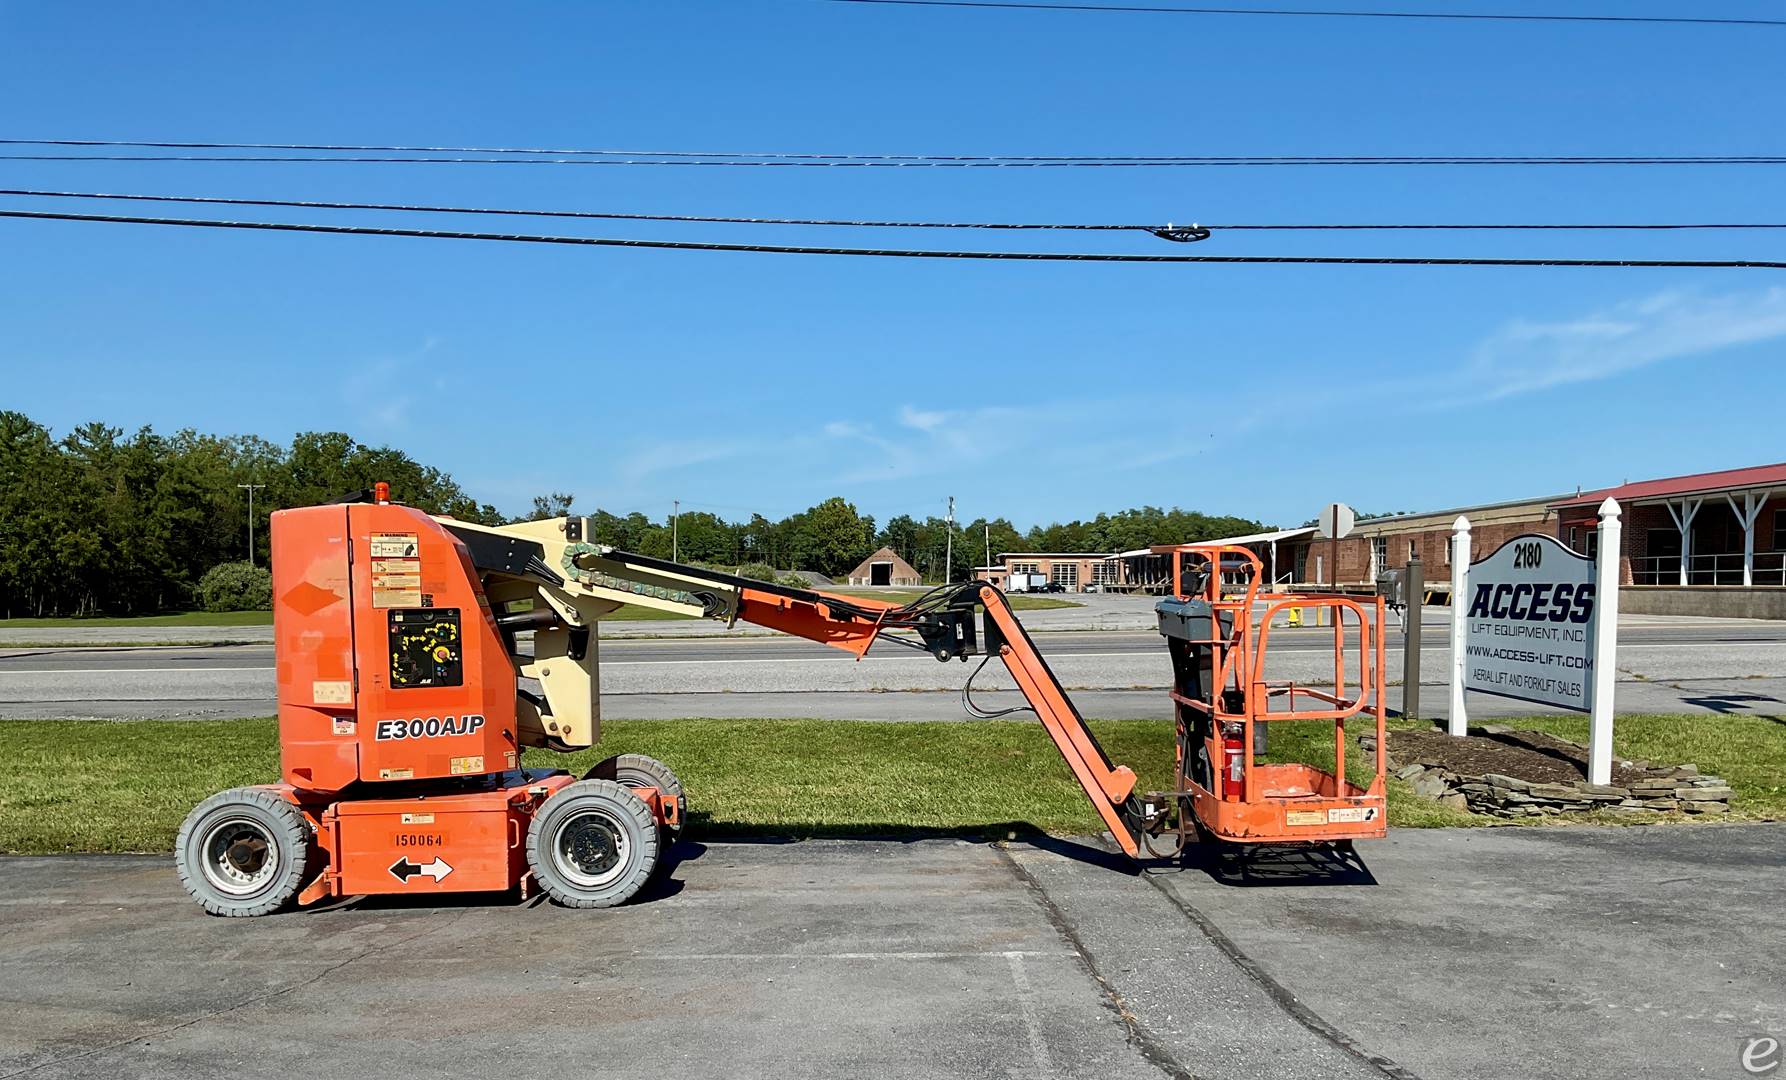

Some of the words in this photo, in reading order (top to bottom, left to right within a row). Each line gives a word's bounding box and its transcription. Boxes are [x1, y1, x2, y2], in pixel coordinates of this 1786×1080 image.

[1514, 542, 1542, 569] 2180
[1467, 583, 1596, 624] ACCESS
[1472, 623, 1492, 634] LIFT
[1494, 625, 1560, 642] EQUIPMENT,
[1562, 629, 1586, 643] INC.
[1466, 645, 1593, 670] WWW.ACCESS-LIFT.COM
[1473, 668, 1495, 683] AERIAL
[1495, 671, 1508, 685] LIFT
[1508, 673, 1522, 688] AND
[1523, 675, 1557, 693] FORKLIFT
[1557, 680, 1581, 698] SALES
[376, 715, 485, 741] E300AJP
[395, 834, 442, 847] 150064
